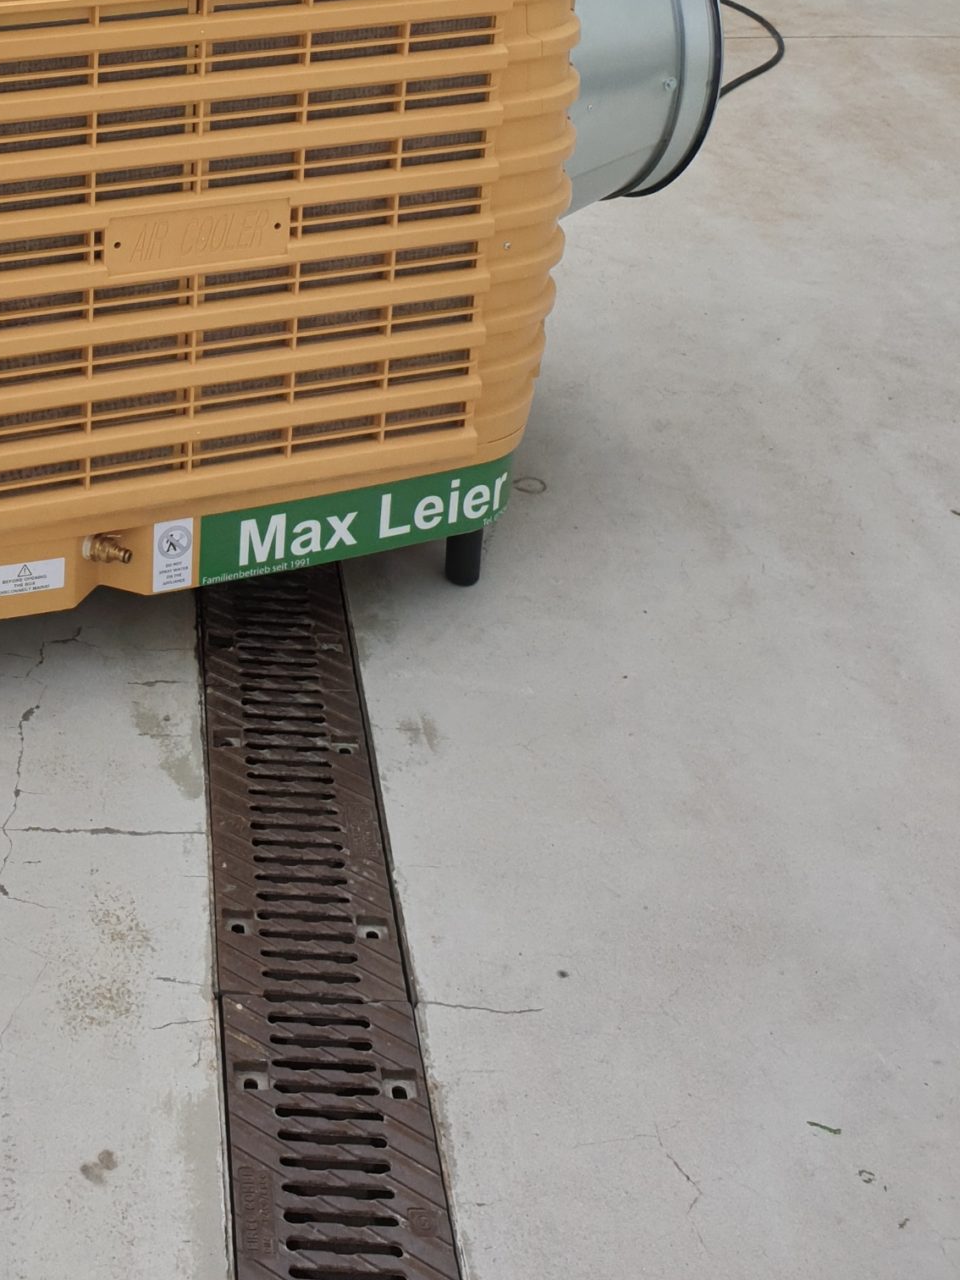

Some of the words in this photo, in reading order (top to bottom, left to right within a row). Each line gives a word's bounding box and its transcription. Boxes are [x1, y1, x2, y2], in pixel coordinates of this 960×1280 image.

[128, 219, 169, 264] AIR
[180, 208, 270, 257] COOLER
[238, 511, 359, 567] Max
[378, 471, 509, 539] Leier
[202, 566, 271, 585] Familienbetrieb
[272, 562, 288, 572] seit
[290, 558, 310, 568] 1991
